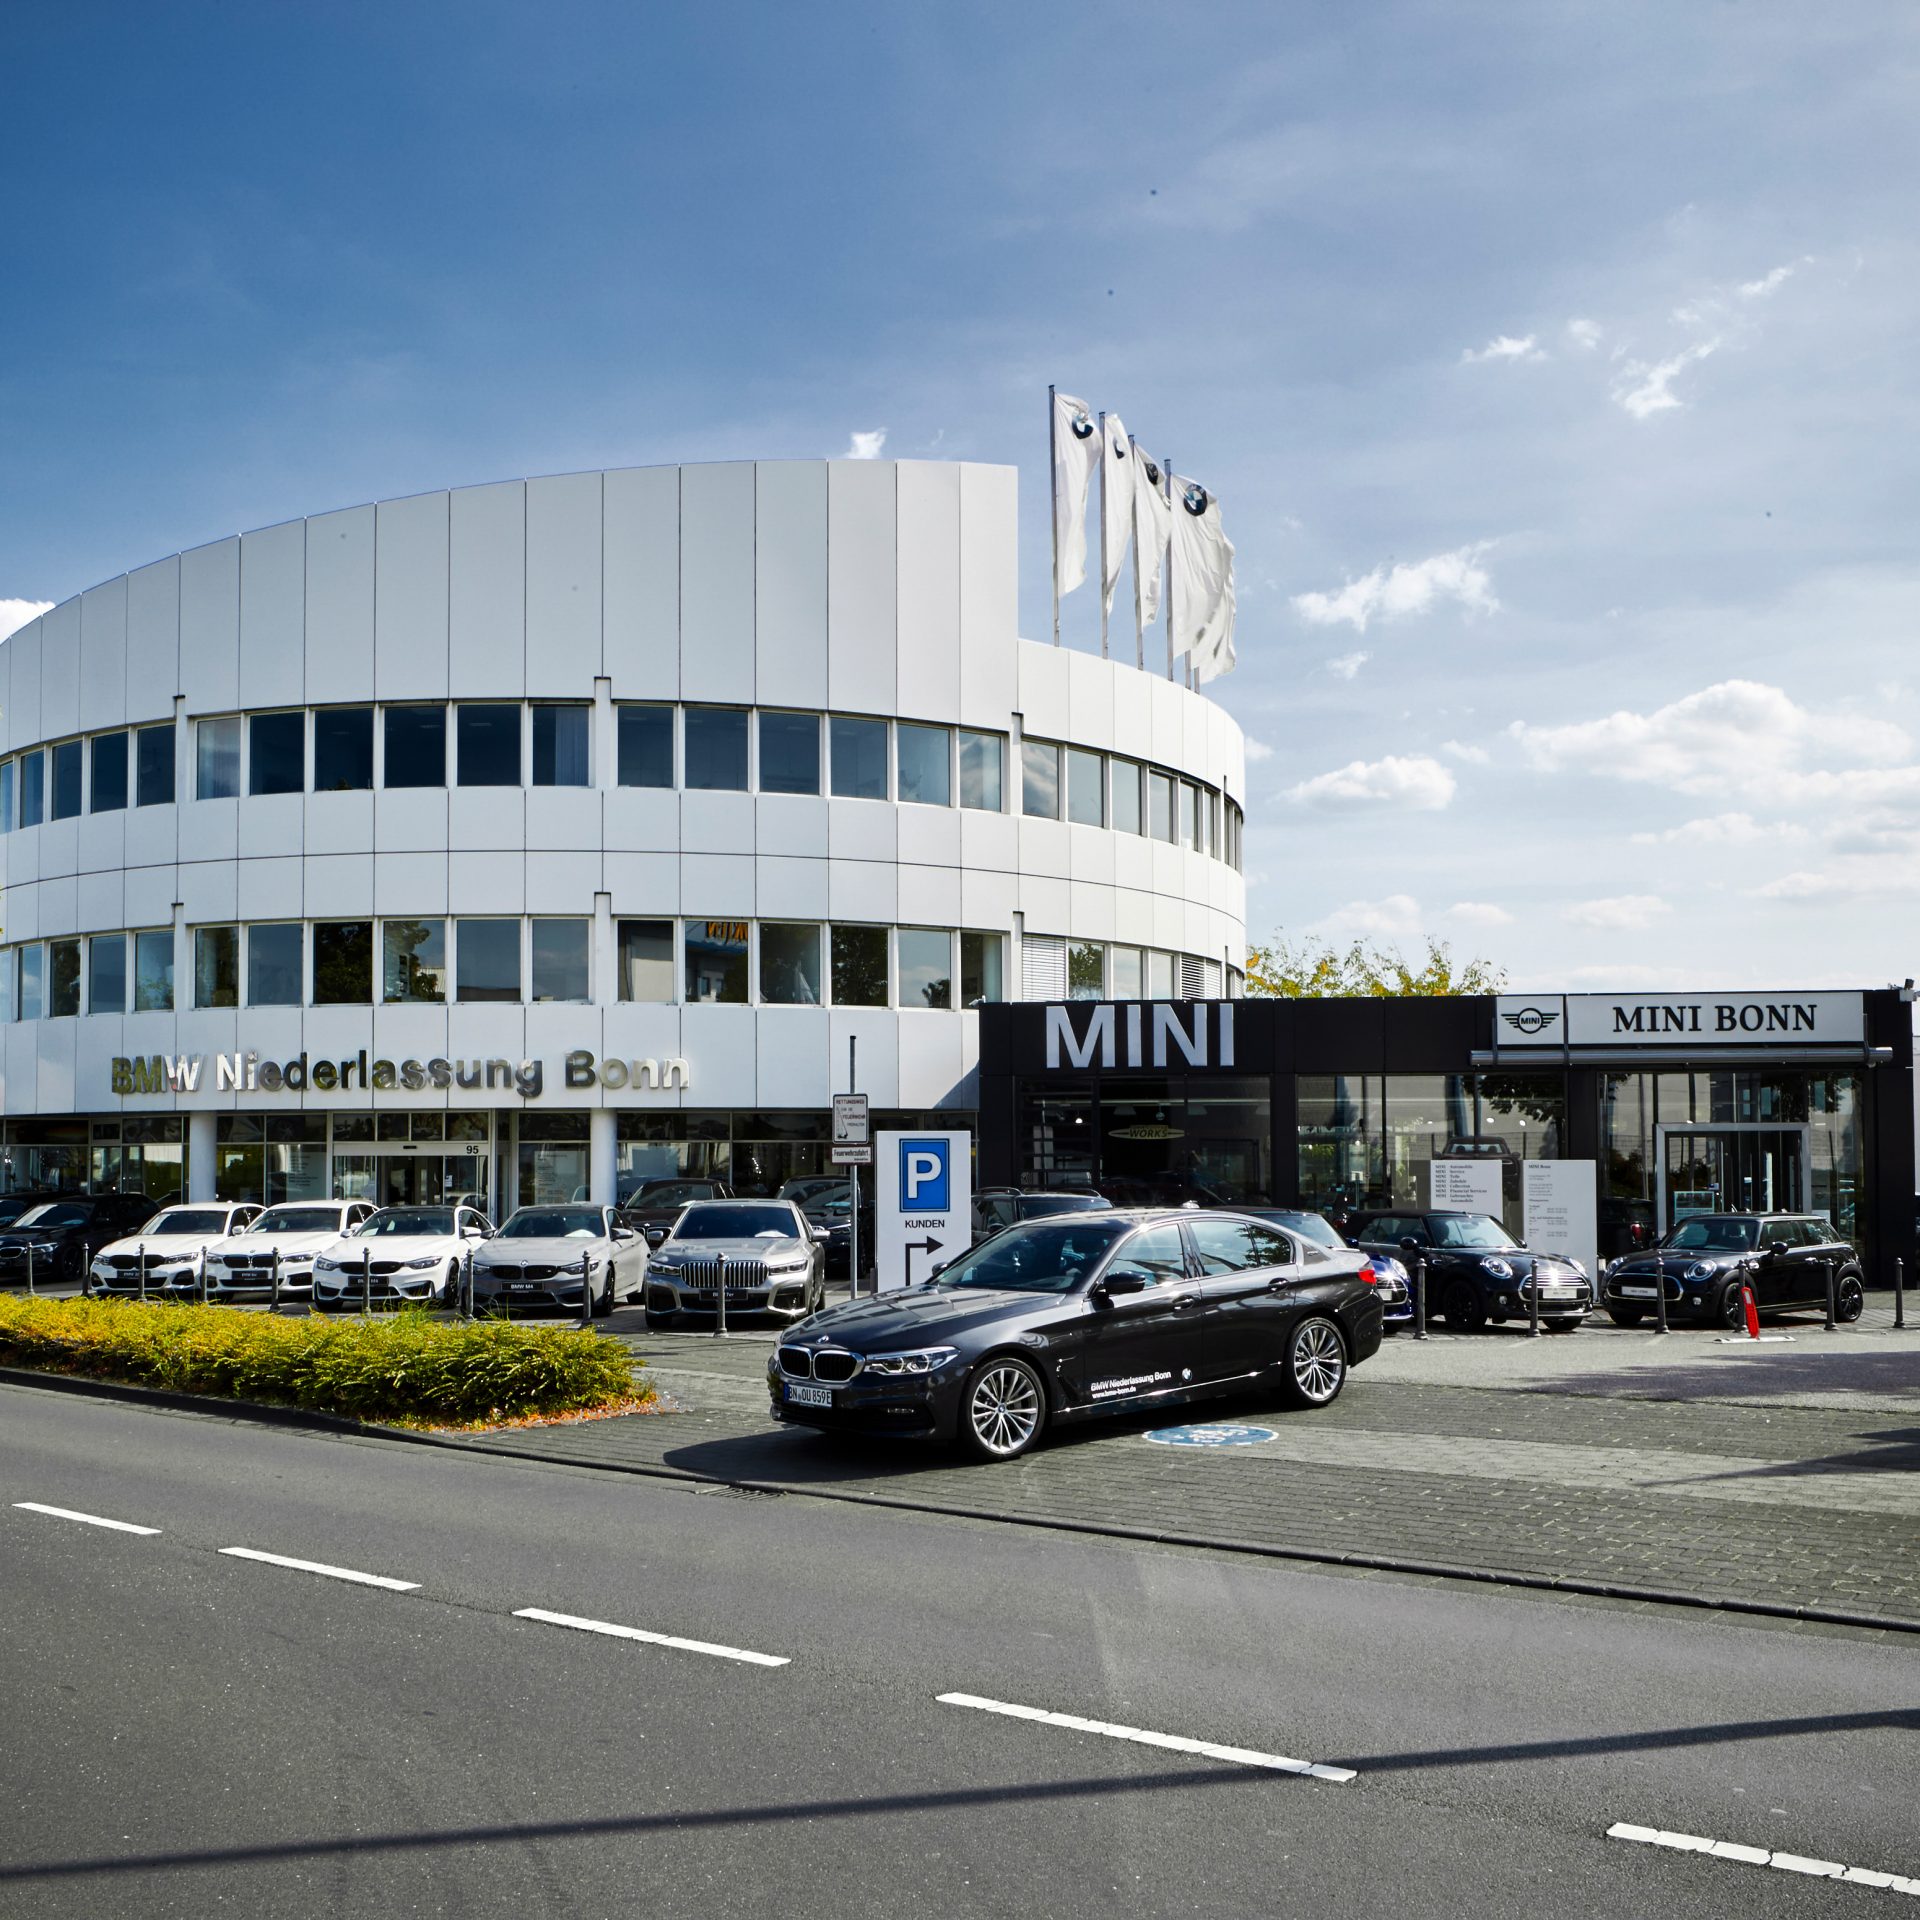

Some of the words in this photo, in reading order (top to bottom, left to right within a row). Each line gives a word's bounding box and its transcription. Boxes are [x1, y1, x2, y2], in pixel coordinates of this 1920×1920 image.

[1520, 1017, 1540, 1025] MINI
[1613, 1006, 1702, 1032] MINI
[1714, 1005, 1817, 1031] BONN
[1046, 1003, 1234, 1069] MINI
[112, 1054, 206, 1094] BMW
[216, 1049, 544, 1099] Niederlassung
[565, 1049, 690, 1090] Bonn
[1129, 1128, 1168, 1138] WORKS
[466, 1145, 479, 1154] 95
[907, 1152, 942, 1199] P
[905, 1219, 945, 1229] KUNDEN
[1091, 1381, 1109, 1392] BMW
[1110, 1374, 1154, 1388] Niederlassung
[1154, 1371, 1172, 1381] Bonn
[802, 1388, 812, 1402] OU
[812, 1390, 832, 1404] 859E
